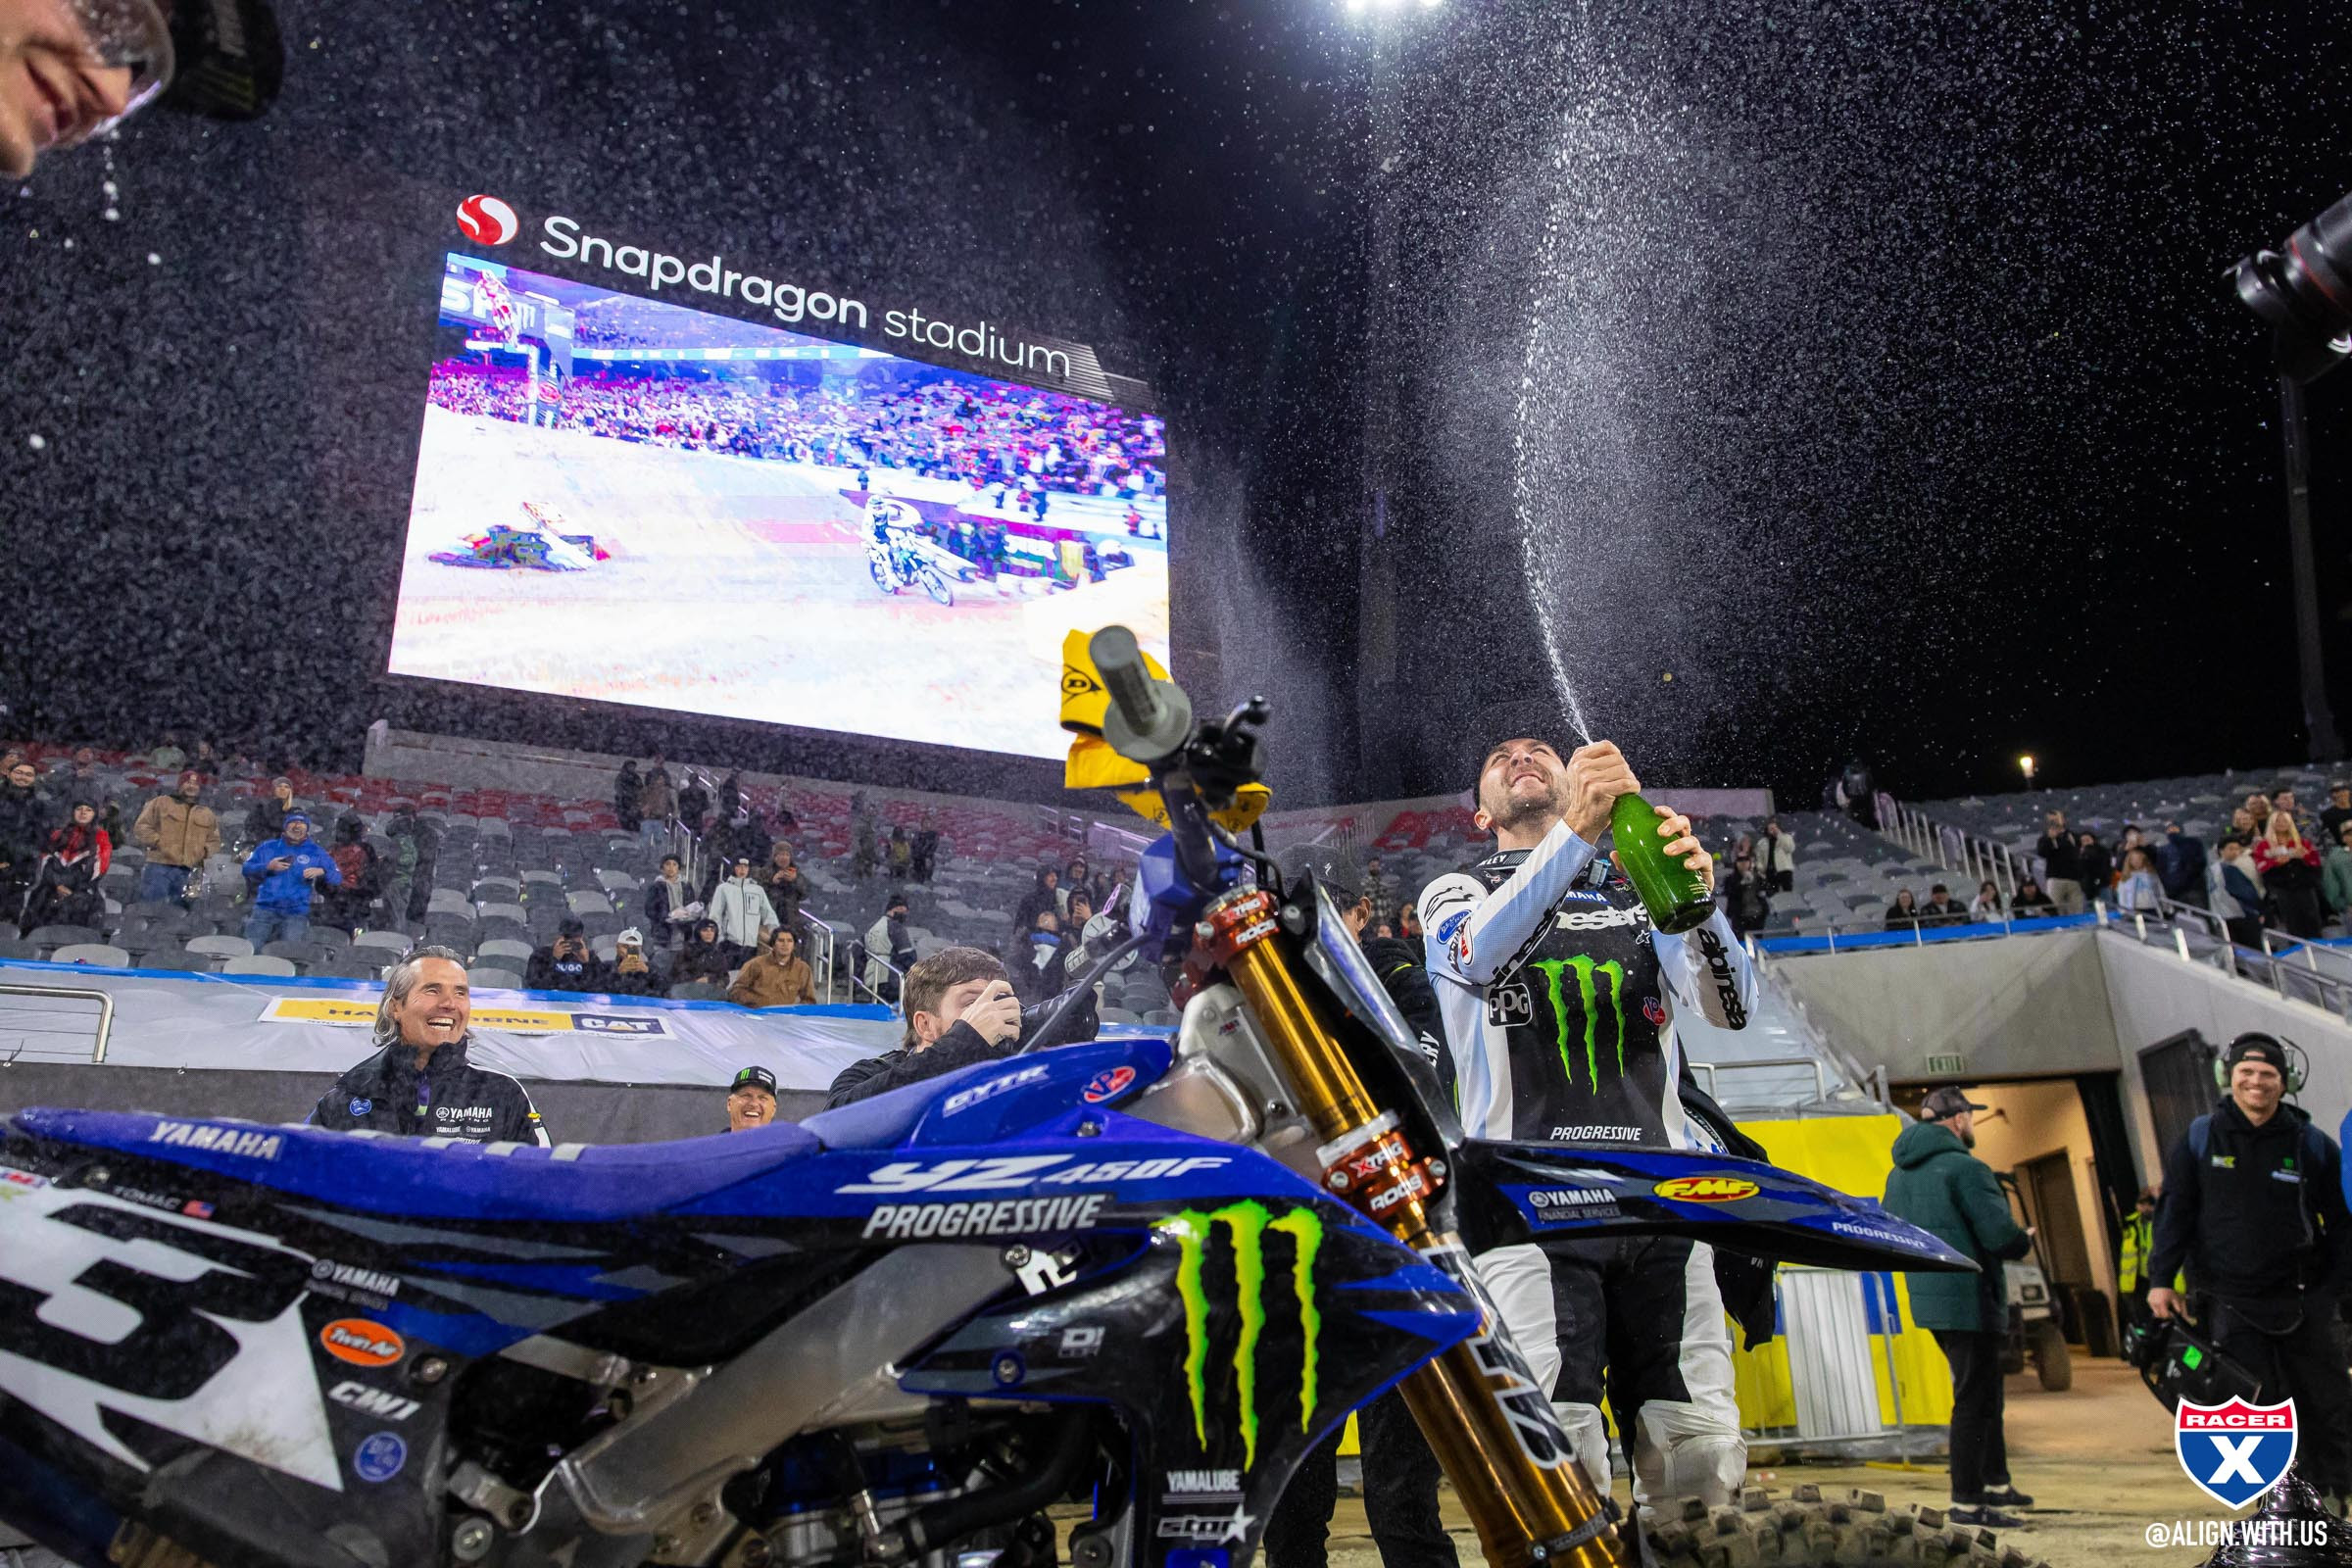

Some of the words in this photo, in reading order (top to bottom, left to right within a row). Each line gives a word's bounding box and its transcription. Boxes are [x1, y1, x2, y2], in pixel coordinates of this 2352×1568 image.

[539, 215, 867, 329] Snapdragon
[884, 308, 1070, 377] stadium
[1489, 989, 1530, 1023] PPG
[581, 1017, 652, 1033] CAT
[450, 1106, 493, 1119] YAMAHA
[148, 1121, 282, 1161] YAMAHA
[1549, 1125, 1642, 1142] PROGRESSIVE
[112, 1185, 182, 1211] TOMAC
[1549, 1188, 1617, 1206] YAMAHA
[1656, 1178, 1757, 1200] FMF
[861, 1193, 1105, 1239] PROGRESSIVE
[331, 1263, 401, 1298] YAMAHA
[1165, 1469, 1242, 1493] YAMALUBE
